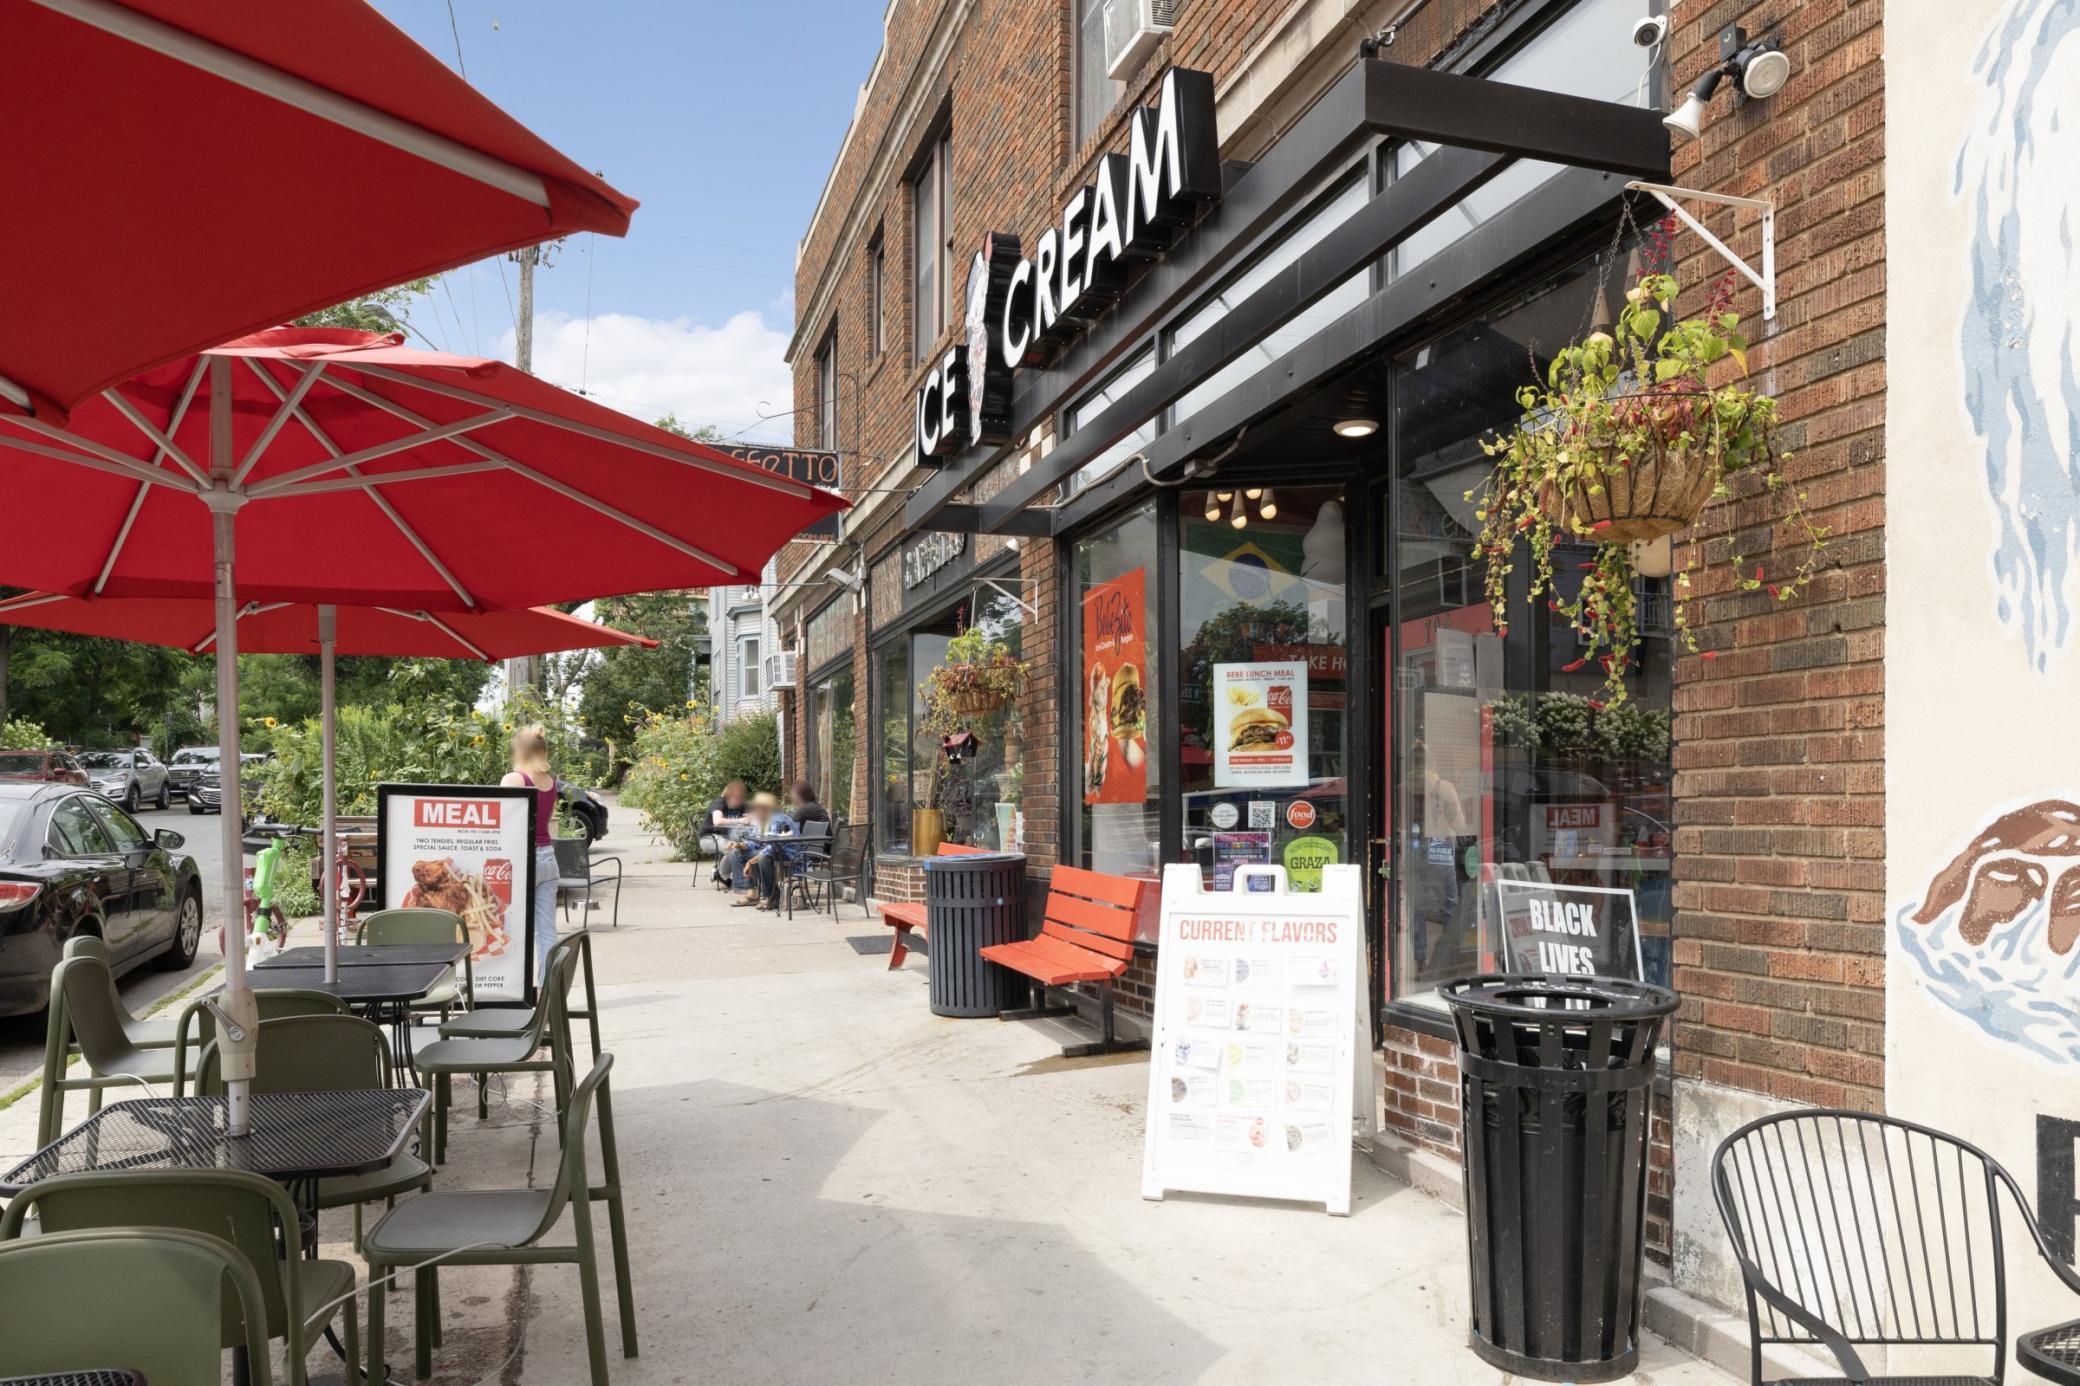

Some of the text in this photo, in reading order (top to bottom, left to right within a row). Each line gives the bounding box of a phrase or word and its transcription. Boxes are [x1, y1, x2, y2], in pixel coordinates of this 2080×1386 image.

[915, 346, 957, 467] ICE
[1003, 67, 1182, 368] CREAM
[1246, 670, 1271, 678] LUNCH
[1274, 669, 1295, 677] MEAL
[423, 802, 498, 825] MEAL
[1290, 808, 1314, 820] food
[1529, 899, 1597, 937] BLACK
[1179, 919, 1338, 943] CURRENT FLAVORS
[1538, 940, 1596, 976] LIVES
